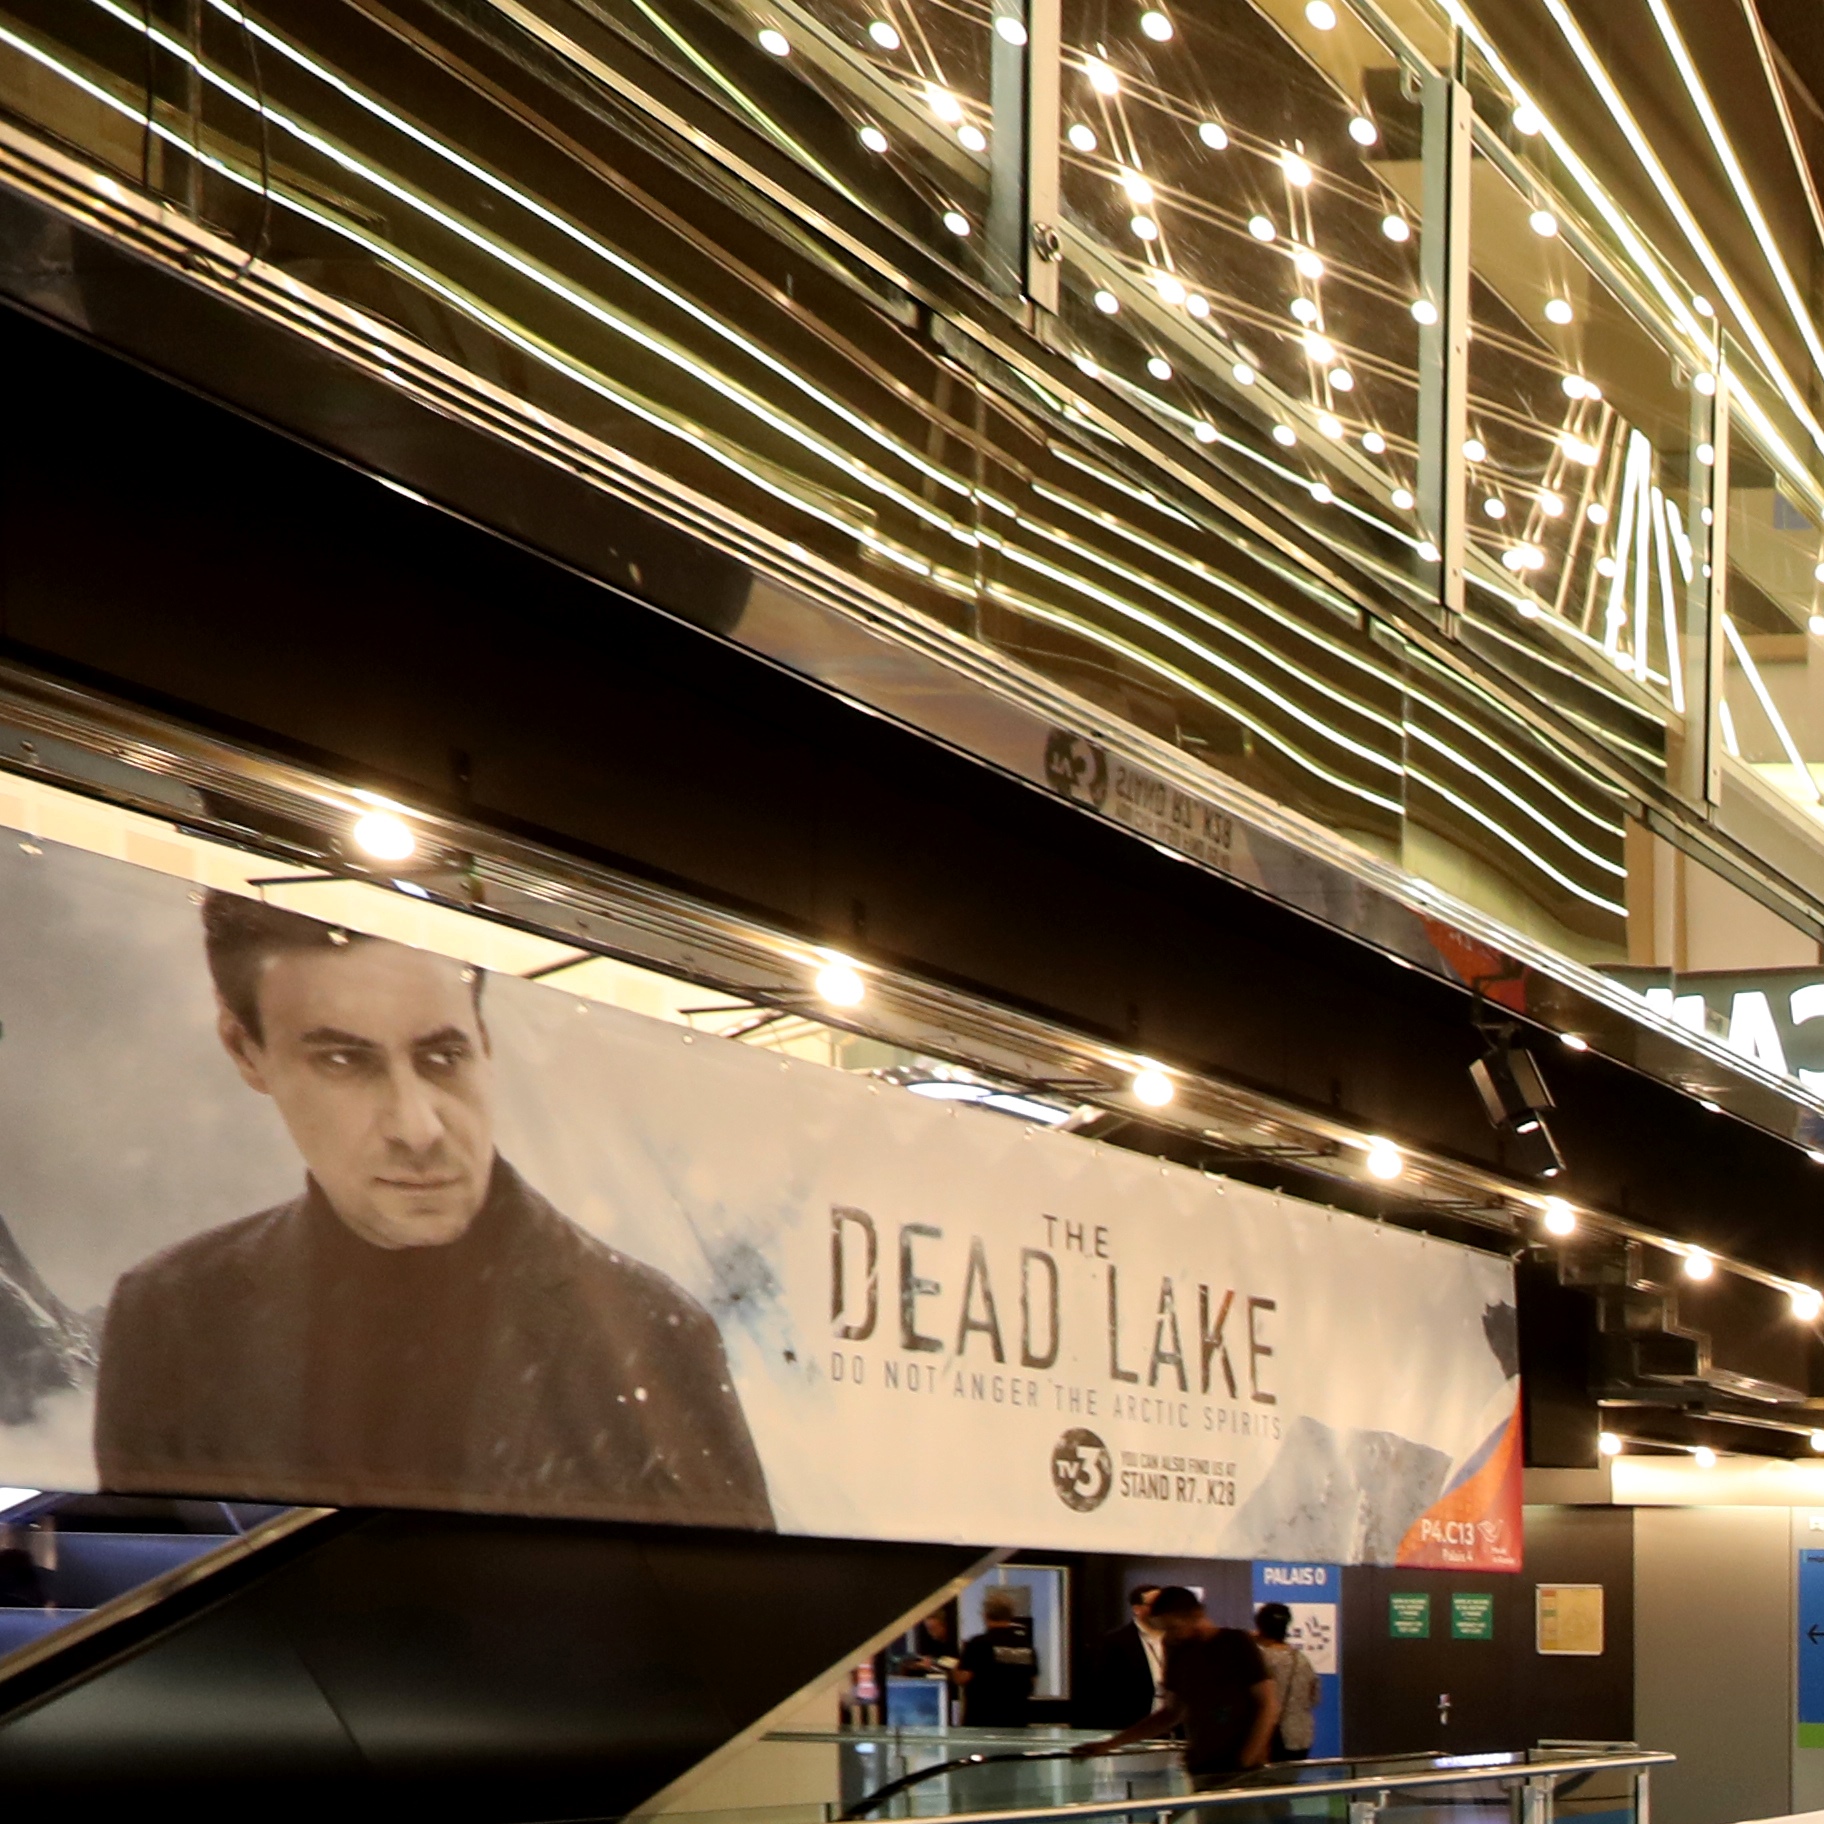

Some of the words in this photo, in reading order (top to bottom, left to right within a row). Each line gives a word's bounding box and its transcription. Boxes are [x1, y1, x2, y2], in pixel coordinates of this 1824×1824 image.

[1041, 1213, 1110, 1259] THE
[830, 1204, 1061, 1370] DEAD
[1107, 1264, 1278, 1406] LAKE
[831, 1351, 865, 1386] DO
[884, 1361, 937, 1396] NOT
[953, 1373, 1040, 1408] ANGER
[1053, 1384, 1099, 1418] THE
[1113, 1396, 1190, 1428] ARCTIC
[1204, 1409, 1282, 1442] SPIRITS
[1056, 1445, 1107, 1498] TV3
[1142, 1452, 1159, 1470] CAN
[1120, 1470, 1169, 1502] STAND
[1207, 1479, 1237, 1508] K28
[1419, 1517, 1476, 1547] P4.C13
[1264, 1567, 1311, 1586] PALAIS
